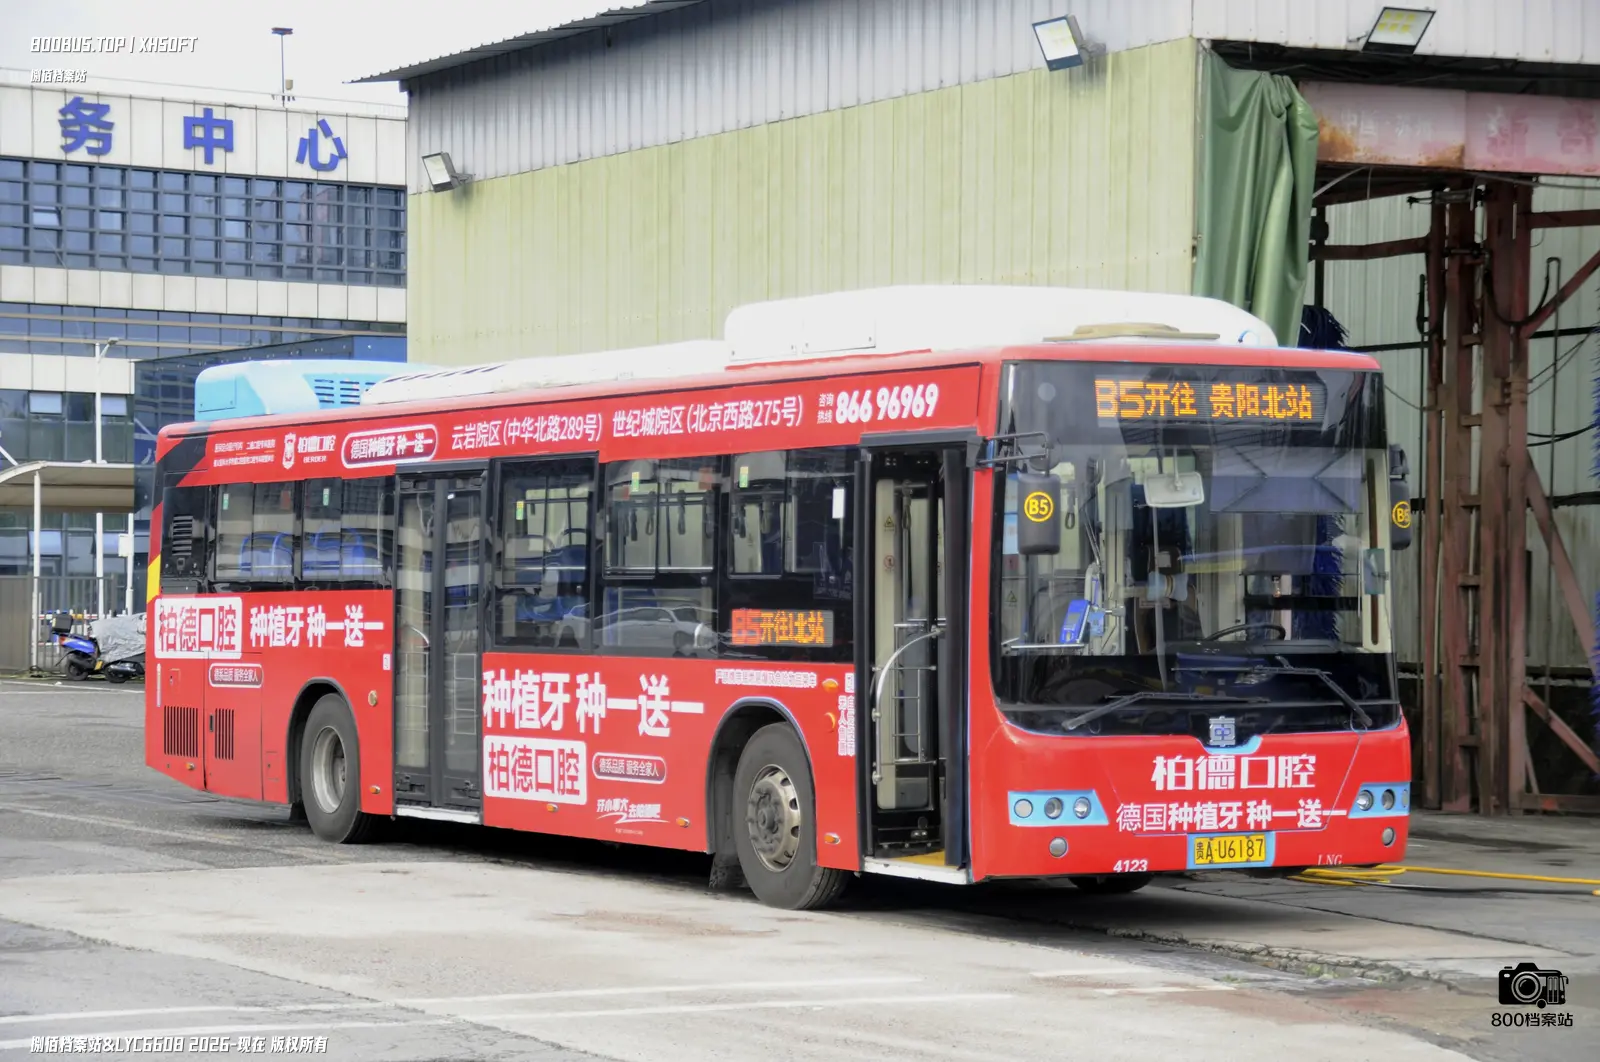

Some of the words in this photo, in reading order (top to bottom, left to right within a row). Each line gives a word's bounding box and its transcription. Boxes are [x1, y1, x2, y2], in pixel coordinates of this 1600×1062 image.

[819, 393, 834, 407] 咨询
[836, 389, 872, 424] 866
[877, 383, 938, 420] 96969
[1209, 383, 1312, 420] 贵阳北站
[350, 435, 395, 459] 德国种植牙
[396, 432, 433, 455] 种一送一
[1028, 497, 1048, 516] B5
[159, 605, 237, 652] 柏德口腔
[250, 604, 304, 647] 种植牙
[306, 604, 384, 647] 种一送一
[482, 668, 571, 731] 种植牙
[576, 672, 704, 737] 种一送一
[488, 742, 580, 796] 柏德口腔
[1150, 753, 1316, 791] 柏德口腔
[1116, 801, 1243, 831] 德国种植牙
[1246, 798, 1347, 828] 种一送一
[1113, 859, 1148, 873] 4123
[1317, 854, 1343, 866] LNG
